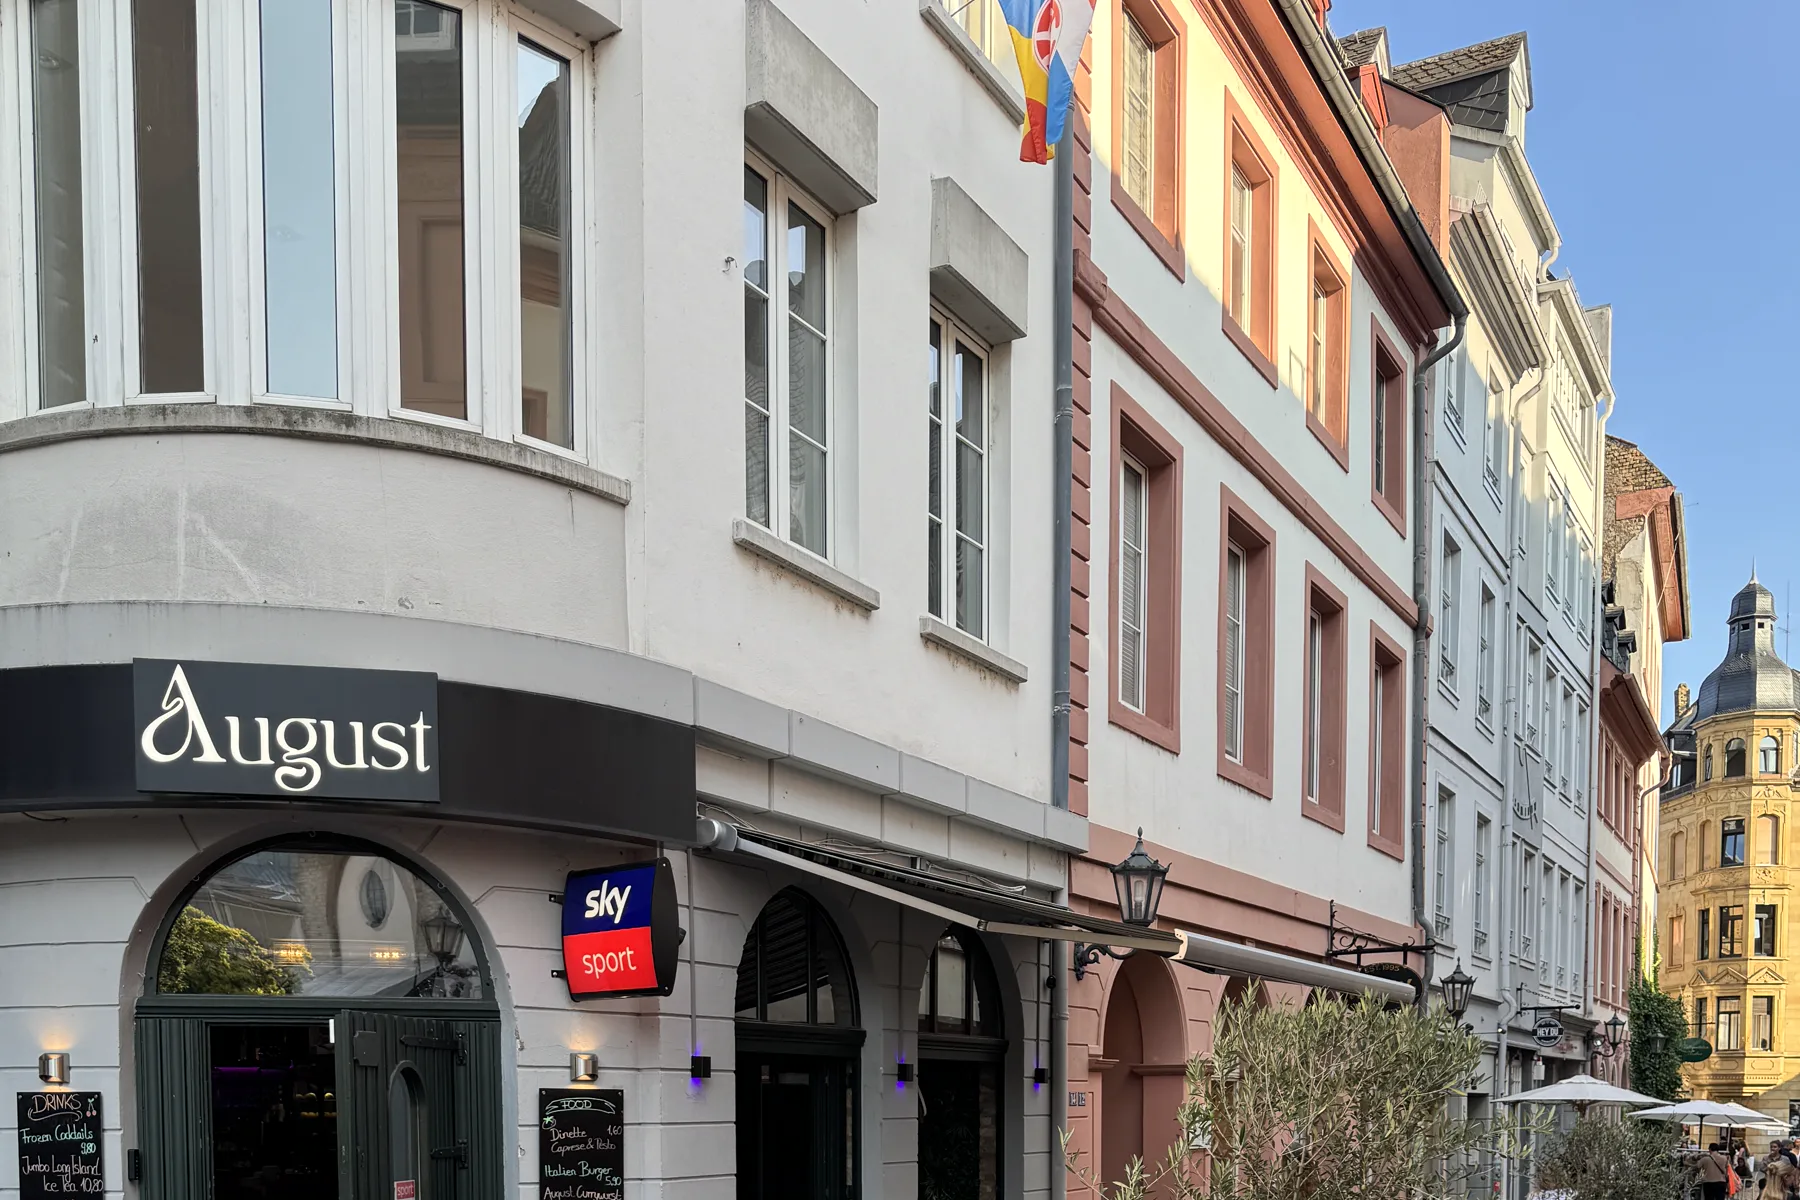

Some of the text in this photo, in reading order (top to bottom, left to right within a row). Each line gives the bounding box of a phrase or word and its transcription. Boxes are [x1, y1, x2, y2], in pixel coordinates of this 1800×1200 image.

[141, 663, 432, 792] August
[584, 879, 632, 924] sky
[582, 946, 637, 979] sport
[31, 1093, 82, 1114] DRINKS
[560, 1100, 592, 1110] FOOD
[20, 1127, 53, 1144] Frozen
[550, 1141, 587, 1157] Caprese
[586, 1137, 595, 1150] &
[21, 1154, 101, 1183] Jumbo Long Island
[577, 1160, 613, 1181] Burger
[43, 1174, 104, 1194] Ice Tea 10,80
[397, 1184, 414, 1198] sport
